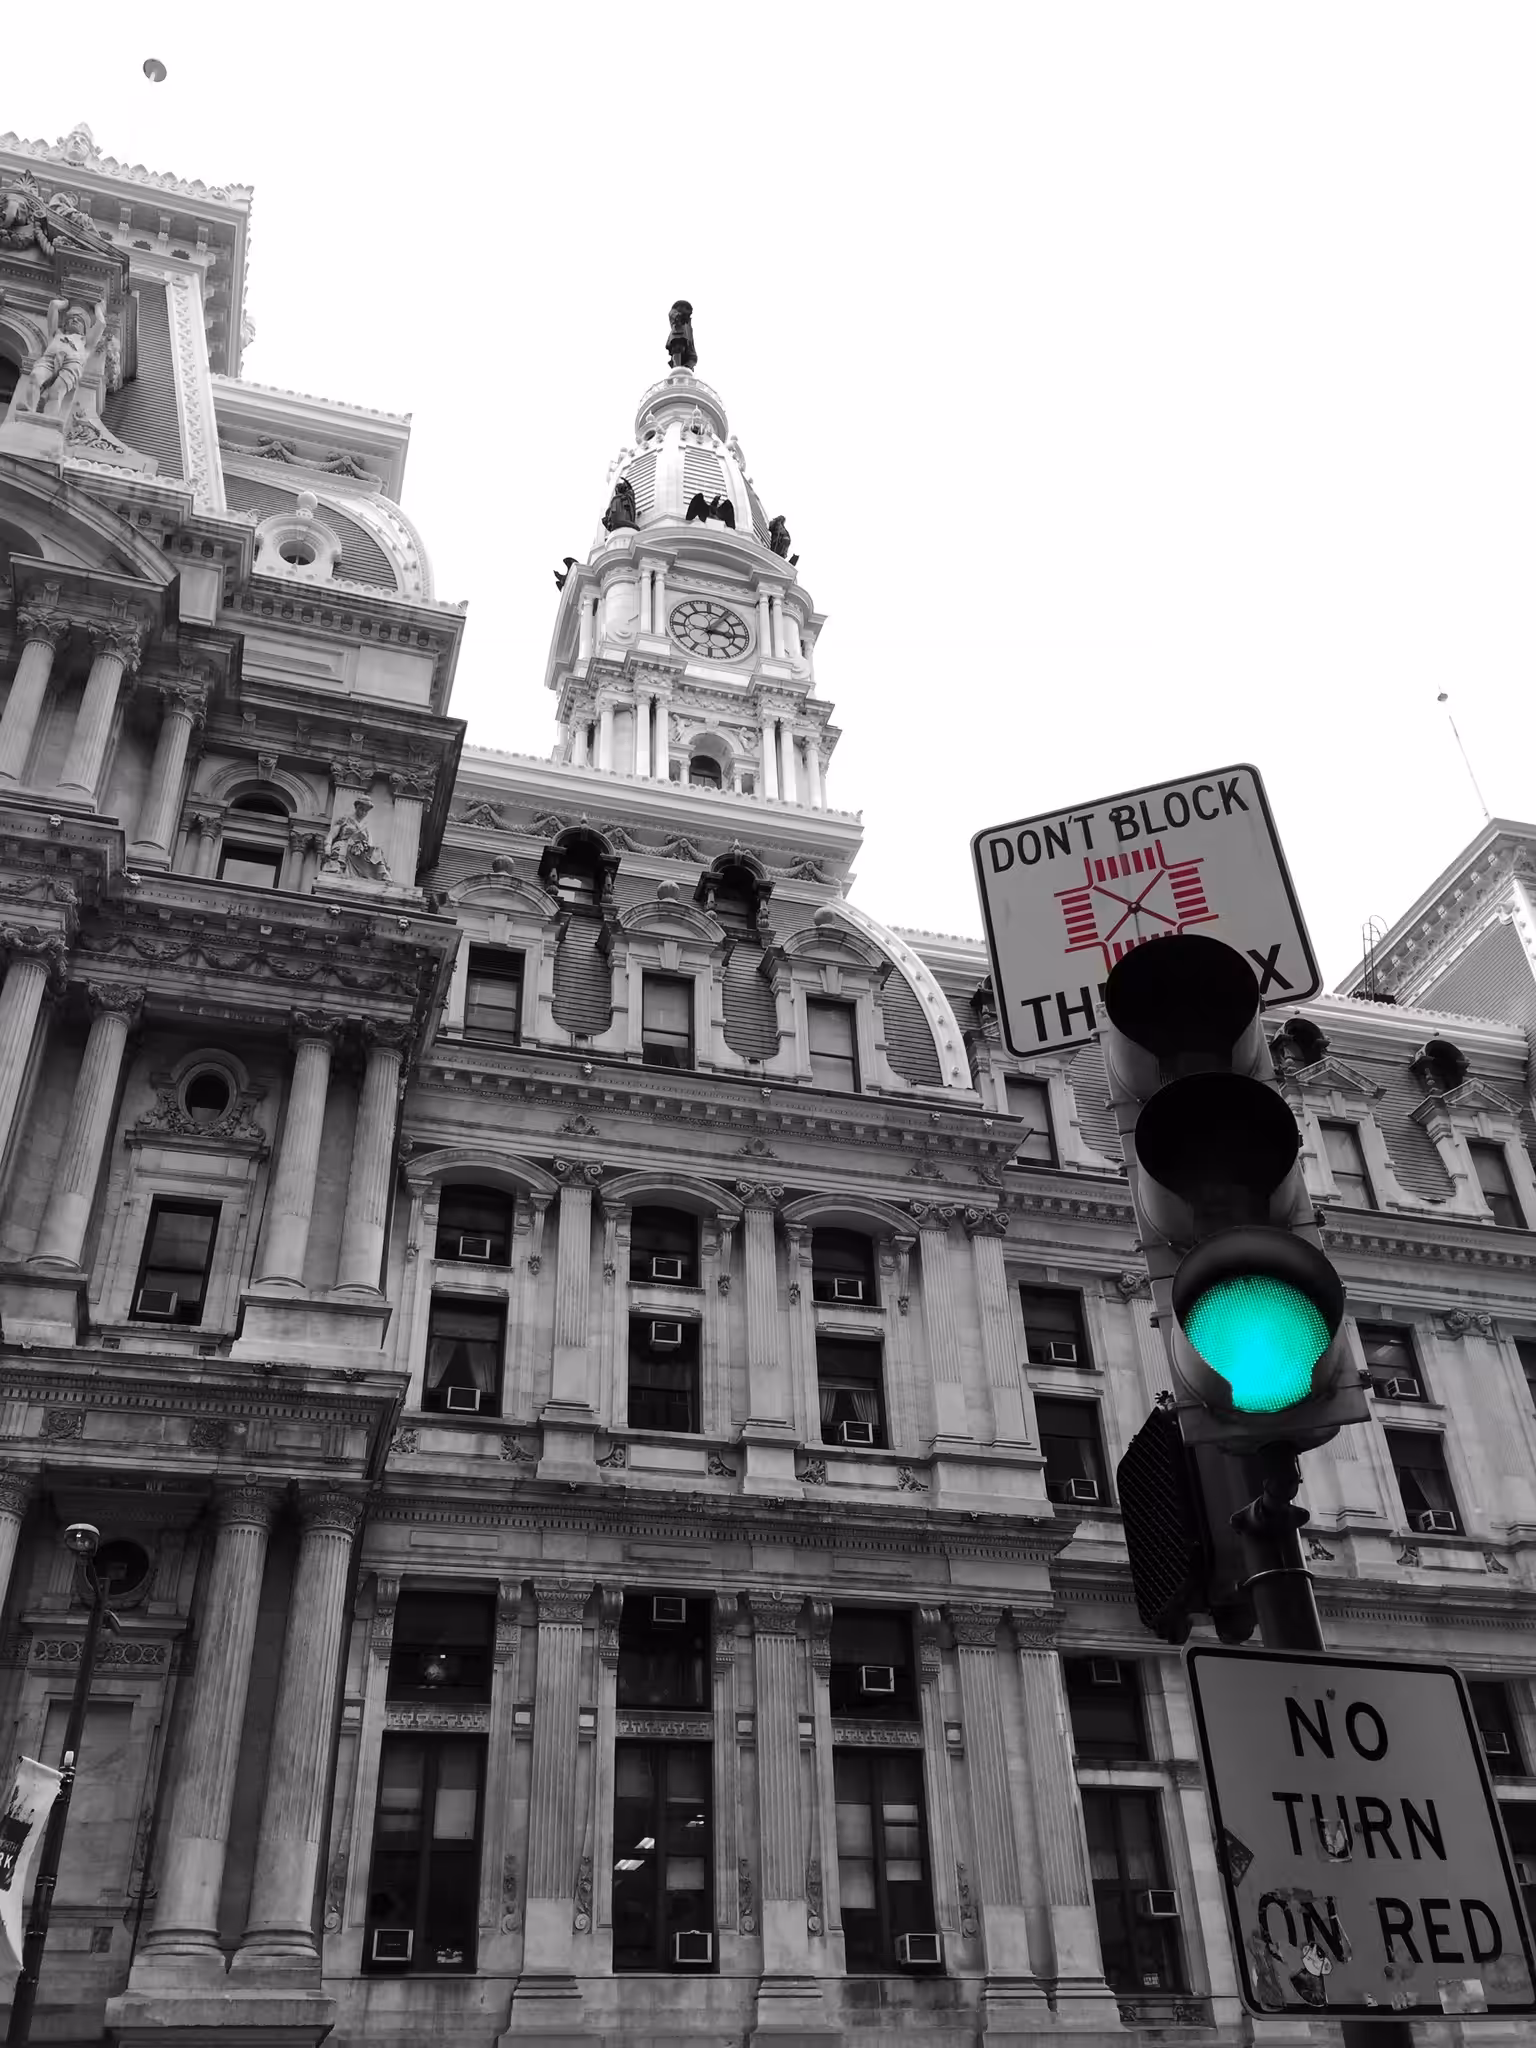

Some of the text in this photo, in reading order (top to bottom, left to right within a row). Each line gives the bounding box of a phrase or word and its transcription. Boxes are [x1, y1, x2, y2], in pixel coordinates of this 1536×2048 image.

[989, 777, 1250, 873] DON'T BLOCK
[1021, 983, 1106, 1042] TH
[1284, 1696, 1389, 1762] NO
[1272, 1791, 1448, 1861] TURN
[1258, 1892, 1503, 1964] ON RED
